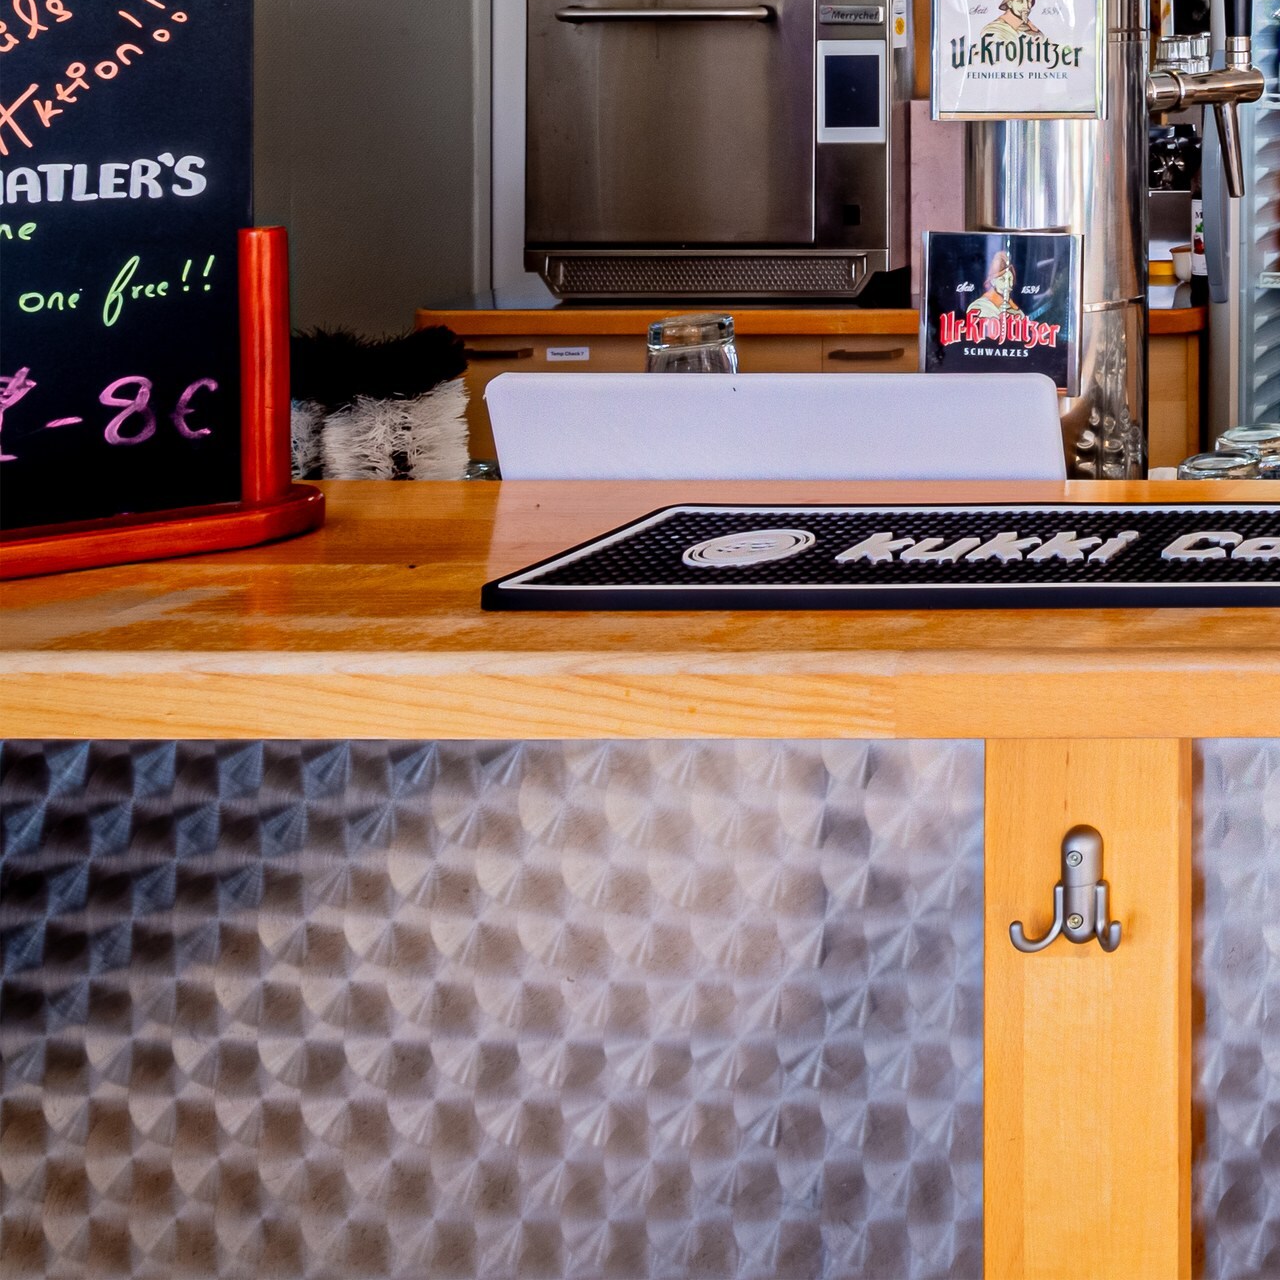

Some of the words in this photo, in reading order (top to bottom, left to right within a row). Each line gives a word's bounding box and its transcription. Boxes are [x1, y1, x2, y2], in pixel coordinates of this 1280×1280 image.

[831, 10, 878, 21] Merrychef
[967, 71, 1024, 80] FEINHERBES
[1028, 71, 1068, 80] PILSNER
[0, 152, 207, 203] ATLER'S
[964, 347, 1029, 358] SCHWARZES
